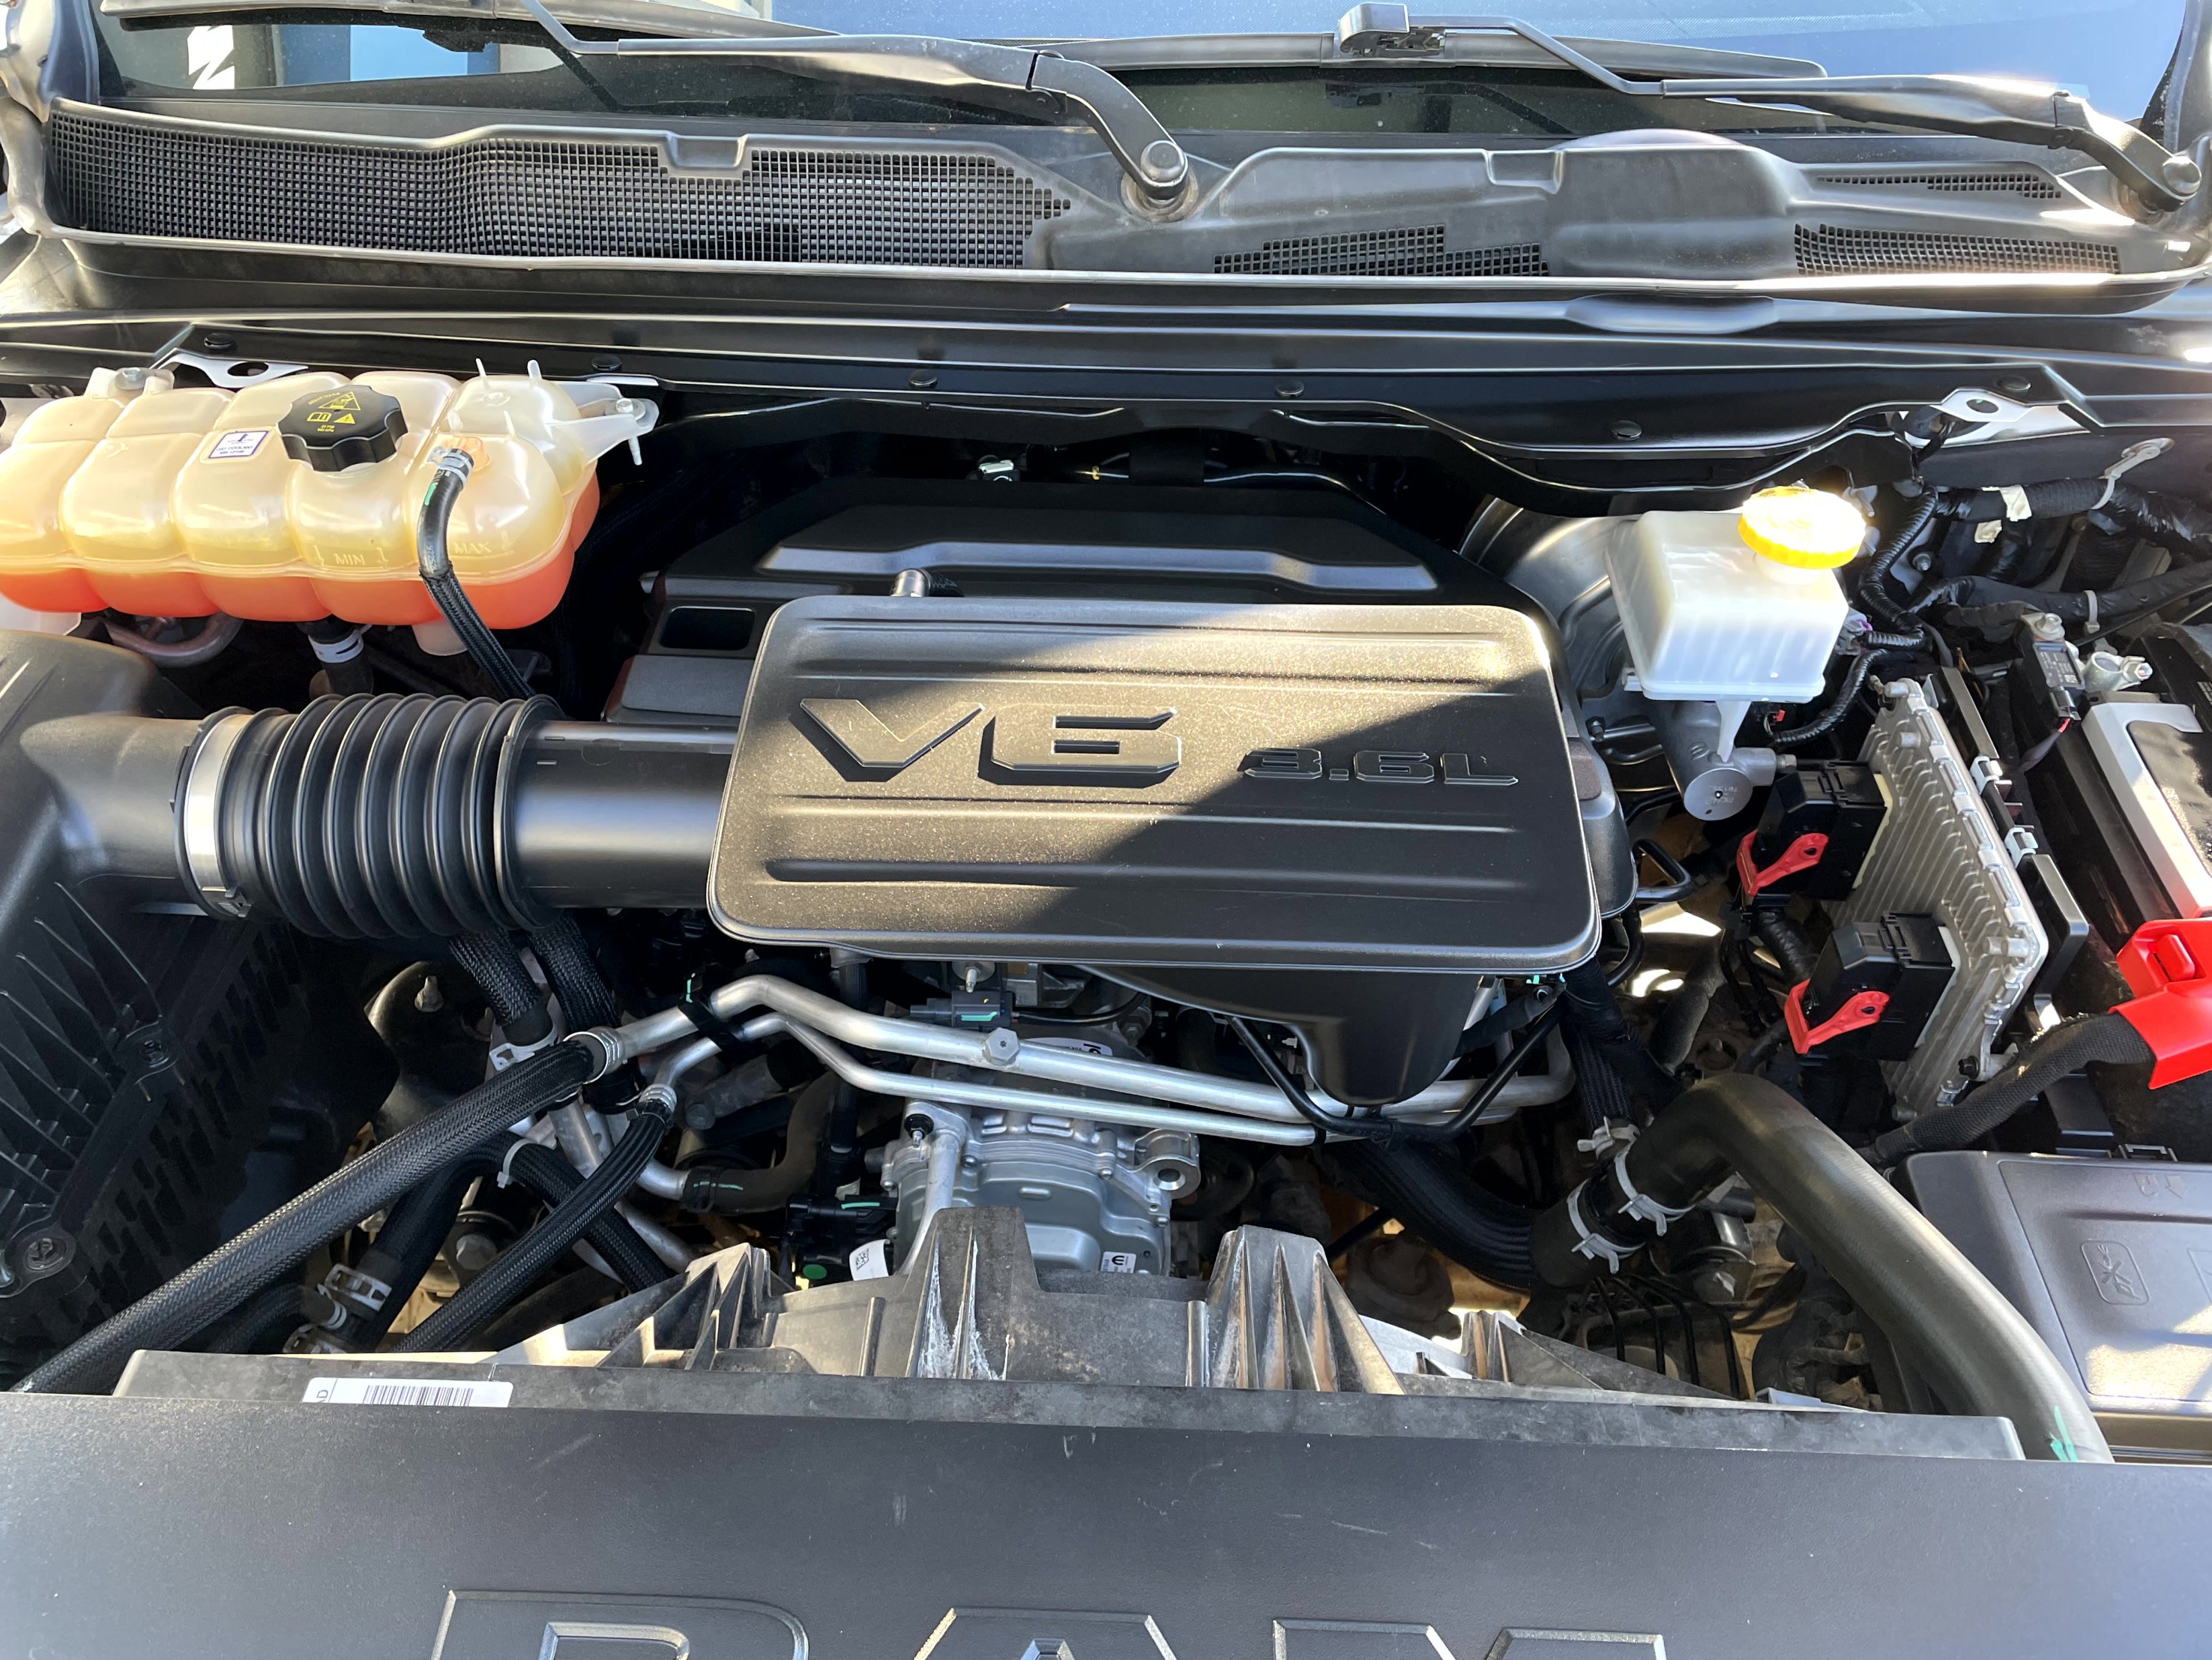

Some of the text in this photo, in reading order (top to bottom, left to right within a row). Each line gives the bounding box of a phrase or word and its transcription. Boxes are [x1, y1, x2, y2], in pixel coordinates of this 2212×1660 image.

[453, 541, 492, 554] MAX
[333, 553, 367, 566] MIN
[800, 697, 1519, 786] V6 3.6L
